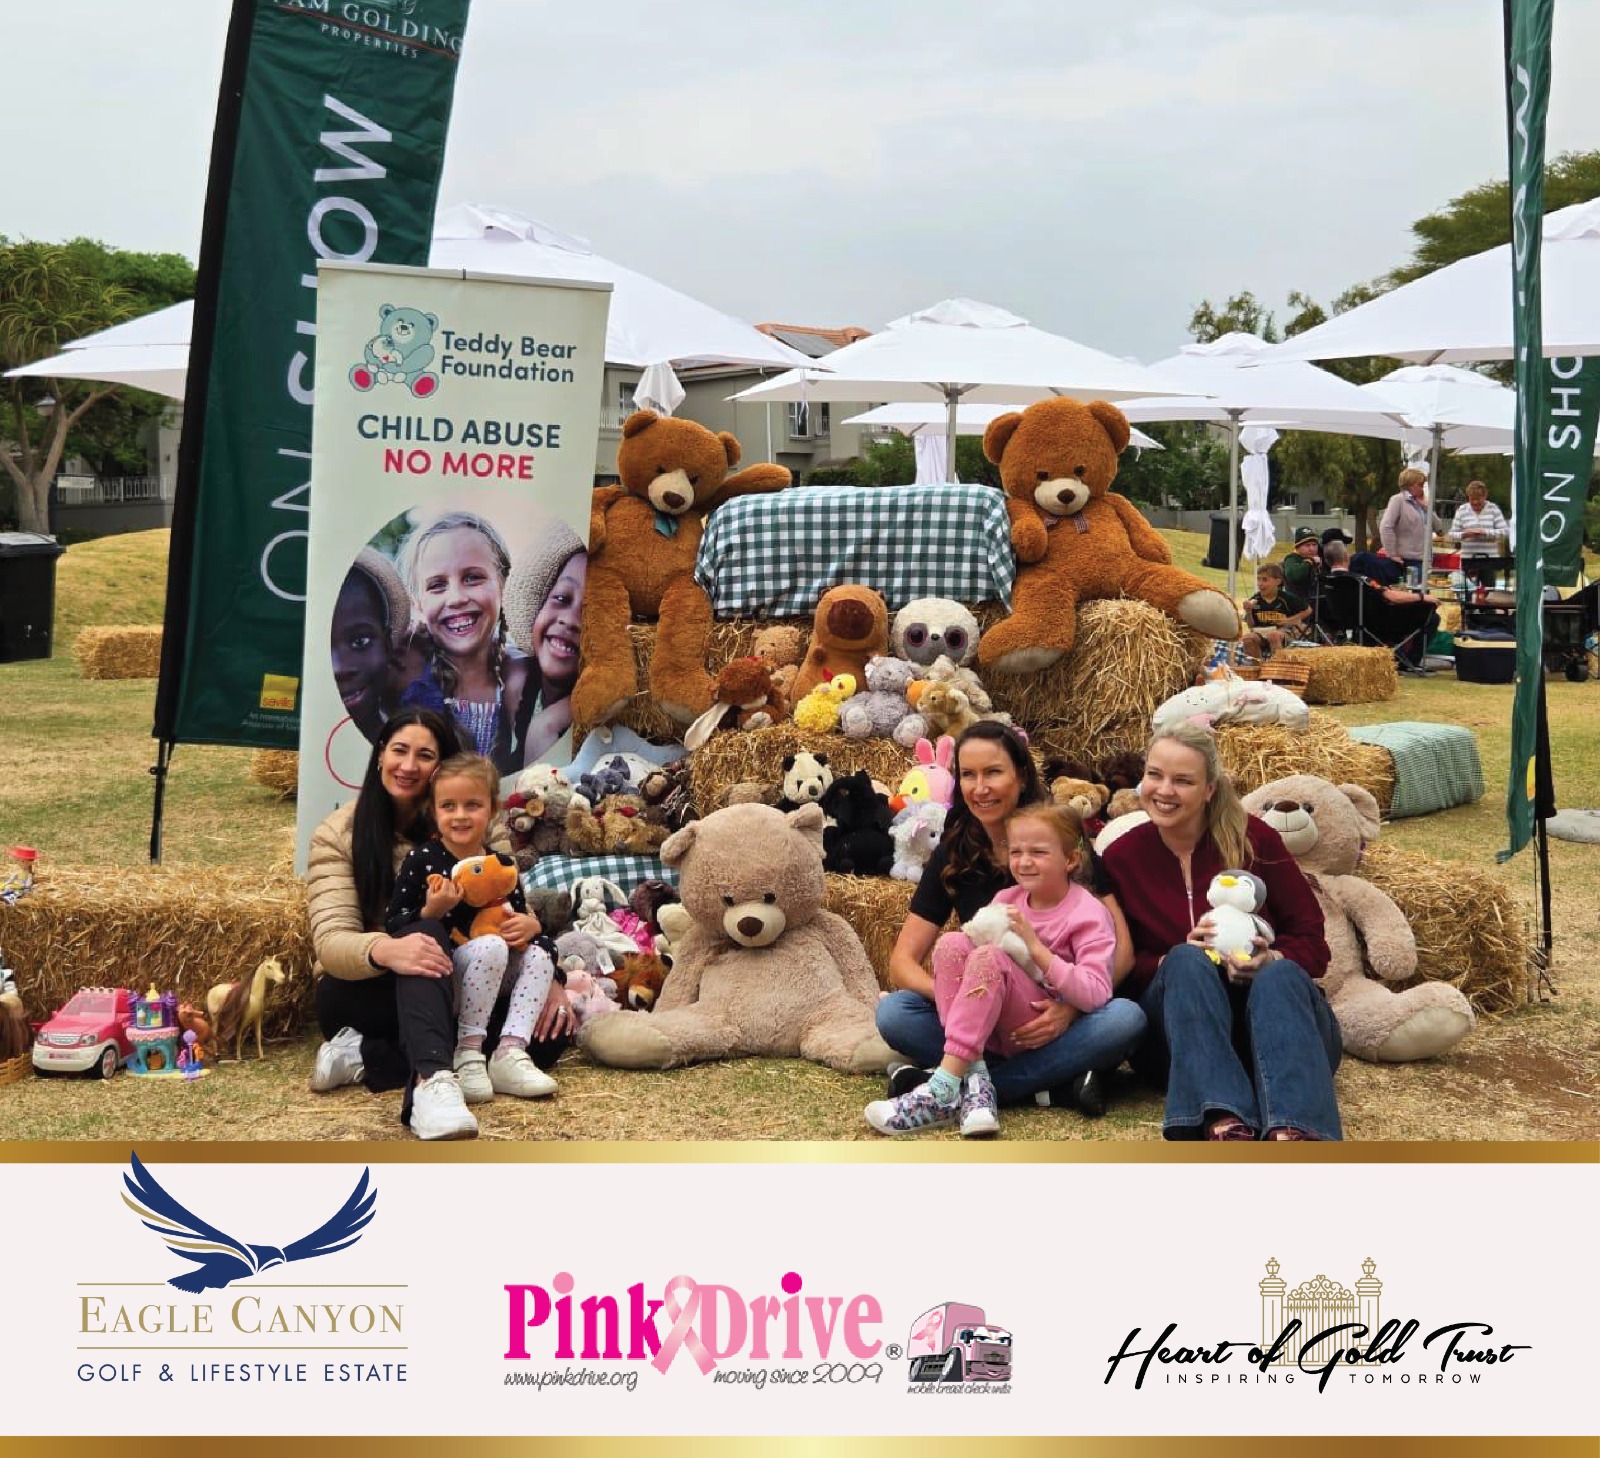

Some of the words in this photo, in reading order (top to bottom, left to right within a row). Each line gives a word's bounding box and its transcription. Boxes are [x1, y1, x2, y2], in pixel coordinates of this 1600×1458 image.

[273, 0, 330, 13] AM
[342, 4, 465, 53] GOLDING
[321, 24, 419, 59] PROPERTIES
[441, 330, 513, 360] Teddy
[521, 336, 578, 359] Bear
[441, 355, 574, 383] Foundation
[1549, 357, 1583, 450] SHO
[357, 414, 454, 442] CHILD
[461, 419, 561, 449] ABUSE
[384, 448, 431, 475] NO
[442, 451, 535, 480] MORE
[1540, 472, 1575, 543] ON
